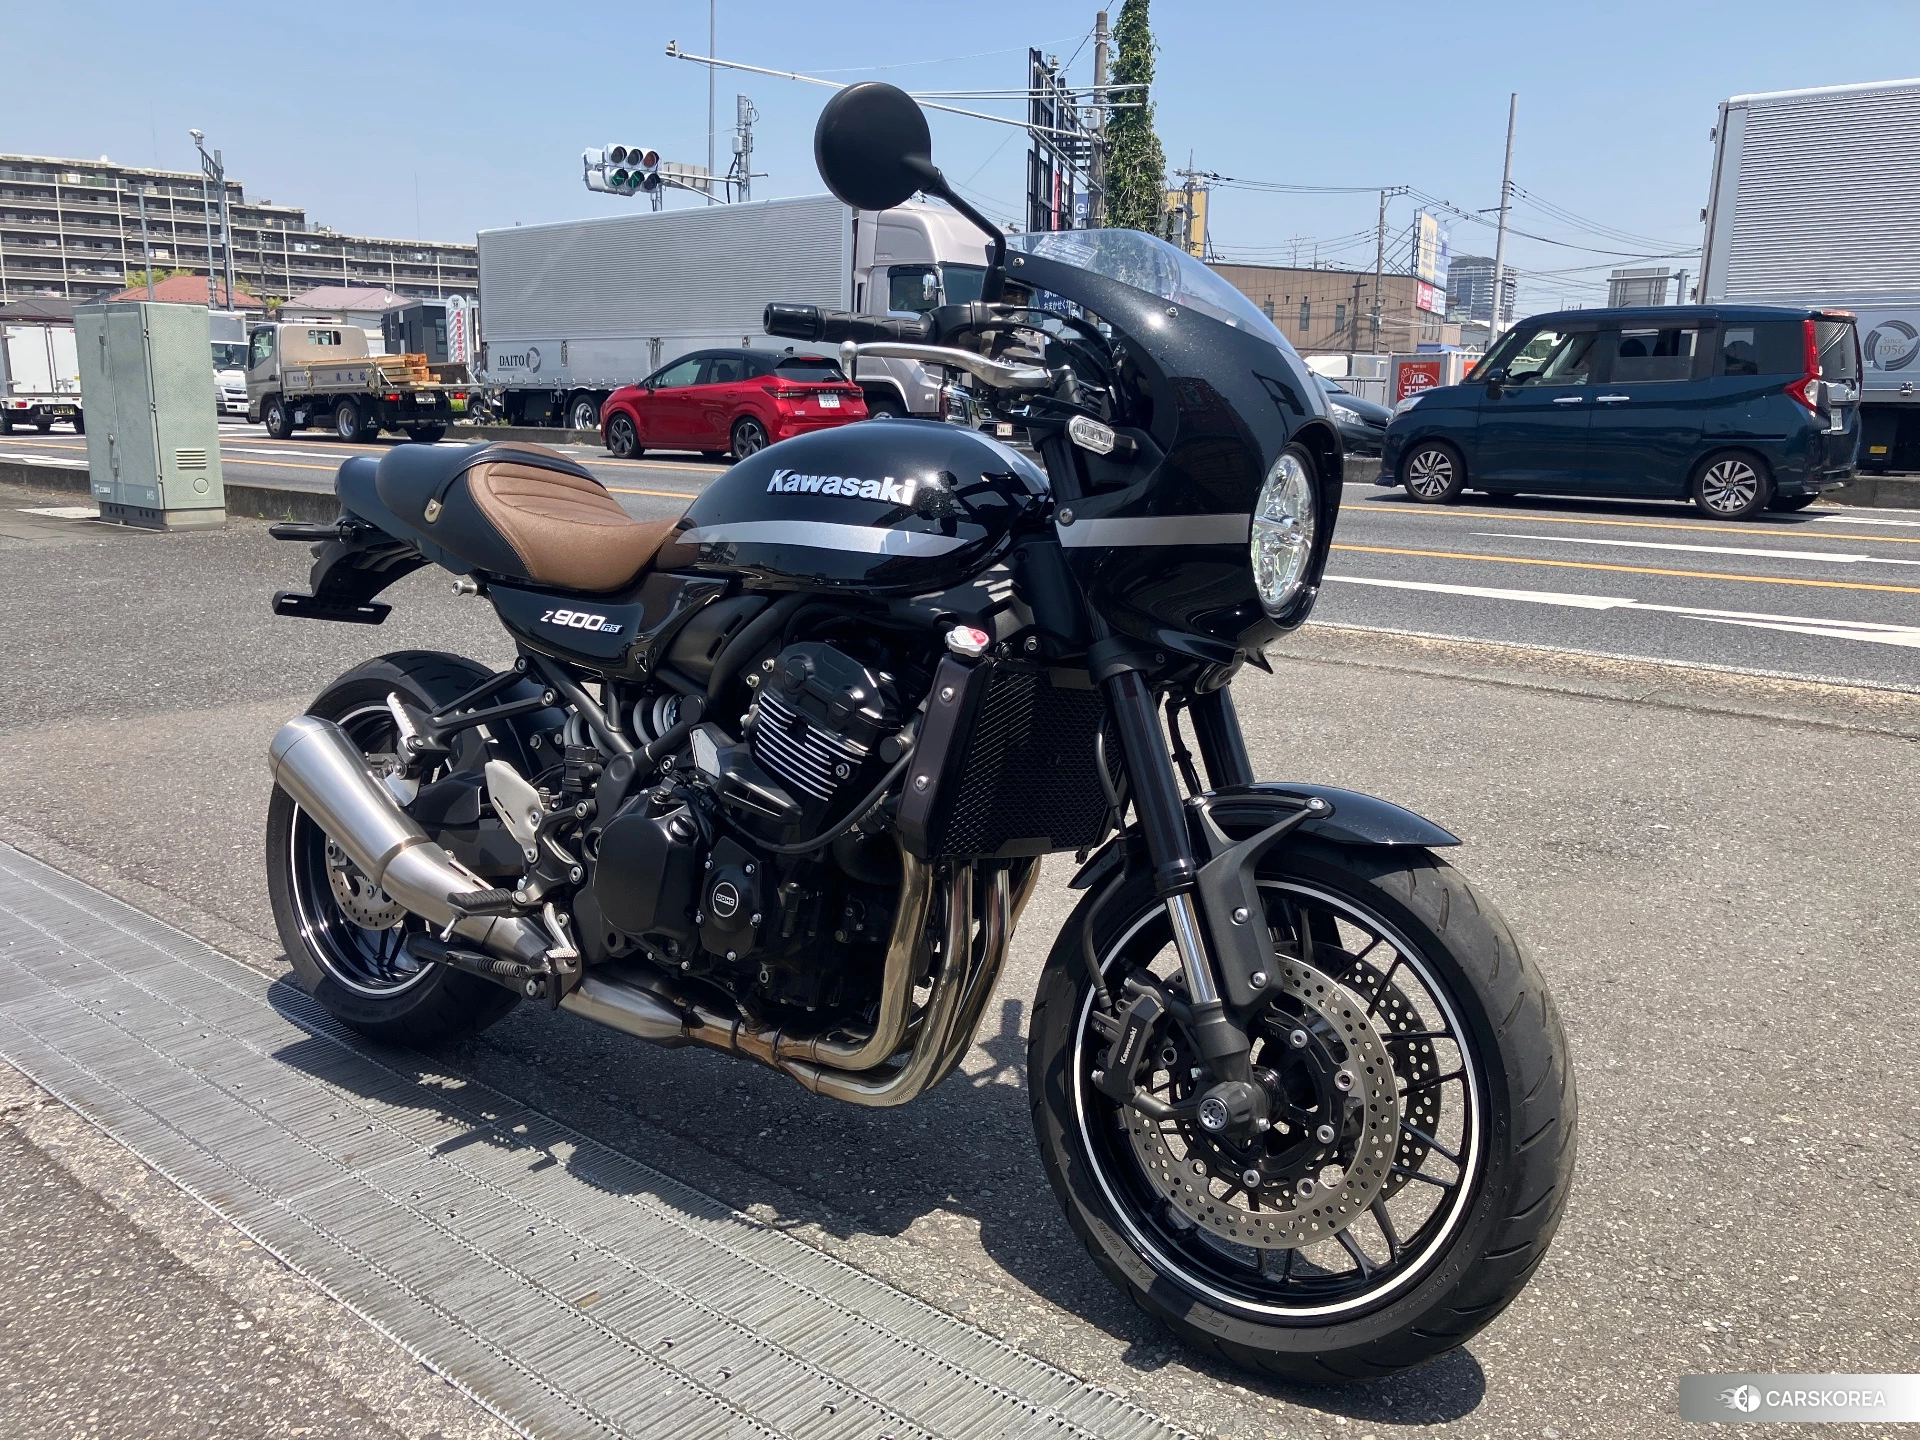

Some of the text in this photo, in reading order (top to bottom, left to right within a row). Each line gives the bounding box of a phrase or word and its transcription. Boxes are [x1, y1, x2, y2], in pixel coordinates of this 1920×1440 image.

[1883, 336, 1903, 344] Since
[1879, 345, 1906, 356] 1956
[1411, 374, 1428, 384] ハロー
[1403, 385, 1434, 396] コン
[766, 469, 917, 507] Kawasaki
[716, 893, 735, 906] DOHC
[1119, 1026, 1138, 1065] Kawasaki
